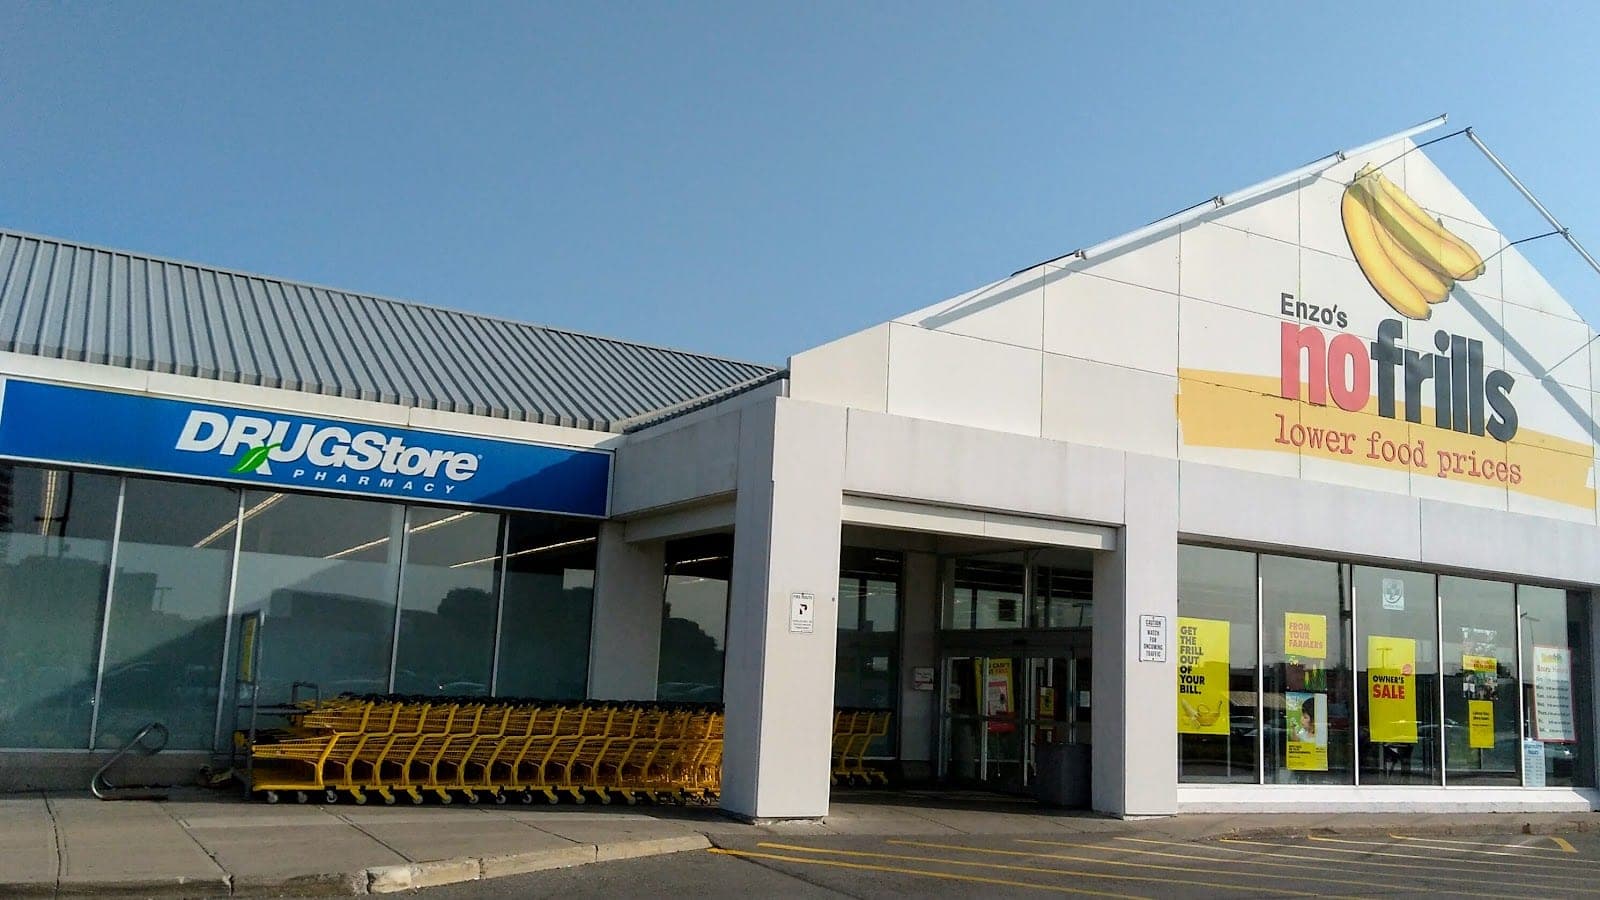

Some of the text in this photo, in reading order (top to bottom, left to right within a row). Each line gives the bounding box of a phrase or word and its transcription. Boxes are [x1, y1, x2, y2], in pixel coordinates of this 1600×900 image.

[1280, 292, 1348, 329] Enzo's
[1274, 413, 1522, 485] lower food prices
[293, 469, 456, 495] PHARMACY
[1180, 626, 1198, 635] GET
[1289, 621, 1311, 632] FROM
[1180, 635, 1197, 645] THE
[1289, 631, 1310, 640] YOUR
[1289, 639, 1323, 649] FARMERS
[1180, 645, 1204, 656] FRILL
[1180, 655, 1200, 665] OUT
[1180, 665, 1193, 674] OF
[1180, 674, 1205, 685] YOUR
[1372, 674, 1405, 684] OWNER'S
[1180, 685, 1202, 694] BILL.
[1372, 684, 1405, 700] SALE
